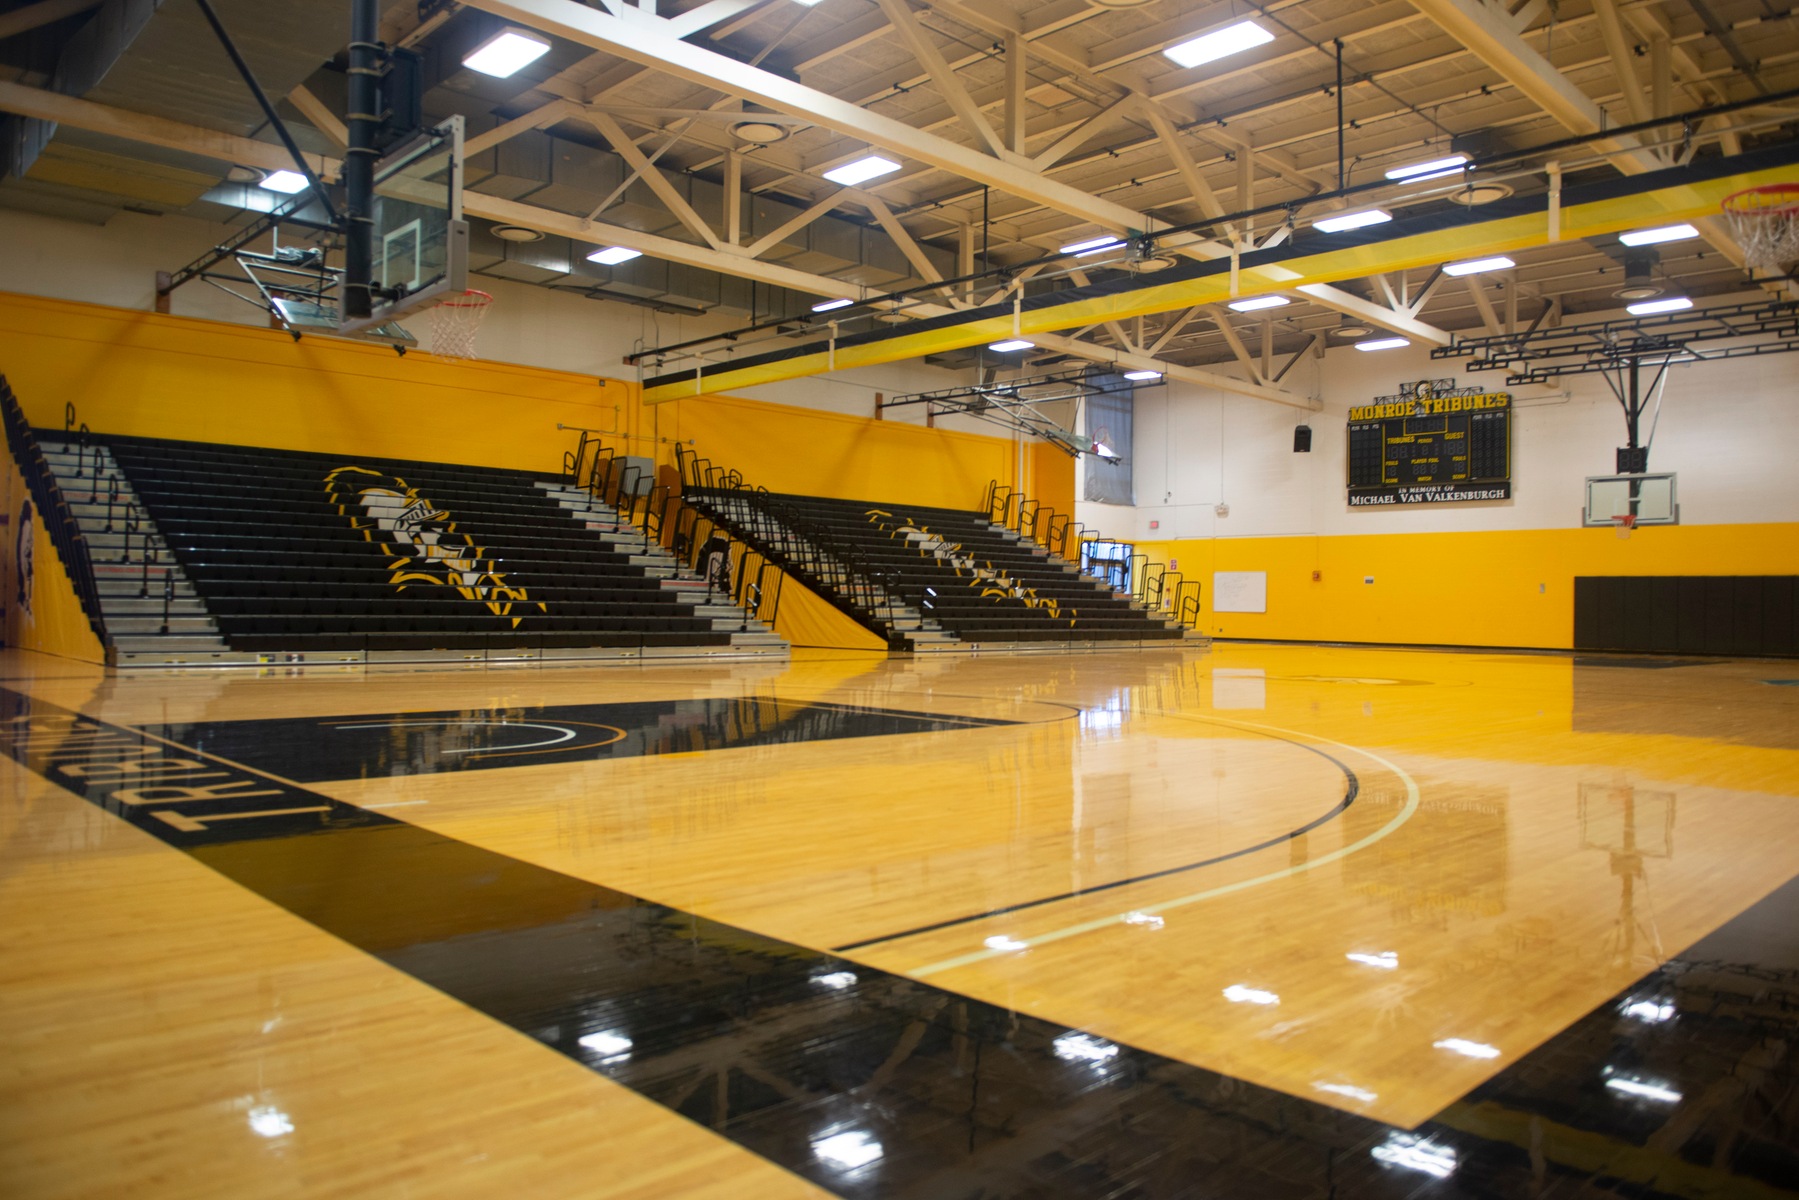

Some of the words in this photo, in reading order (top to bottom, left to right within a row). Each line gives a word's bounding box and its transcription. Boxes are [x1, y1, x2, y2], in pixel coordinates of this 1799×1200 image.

[1350, 401, 1415, 421] MONROE
[1423, 392, 1507, 414] TRIBUNES
[1387, 435, 1415, 445] TRIBUNES
[1444, 431, 1465, 440] GUEST
[1408, 486, 1442, 494] MEMORY
[1444, 484, 1455, 492] OF
[1351, 495, 1396, 505] MICHAEL
[1401, 494, 1423, 503] VAN
[1426, 490, 1505, 502] VALKENBURGH
